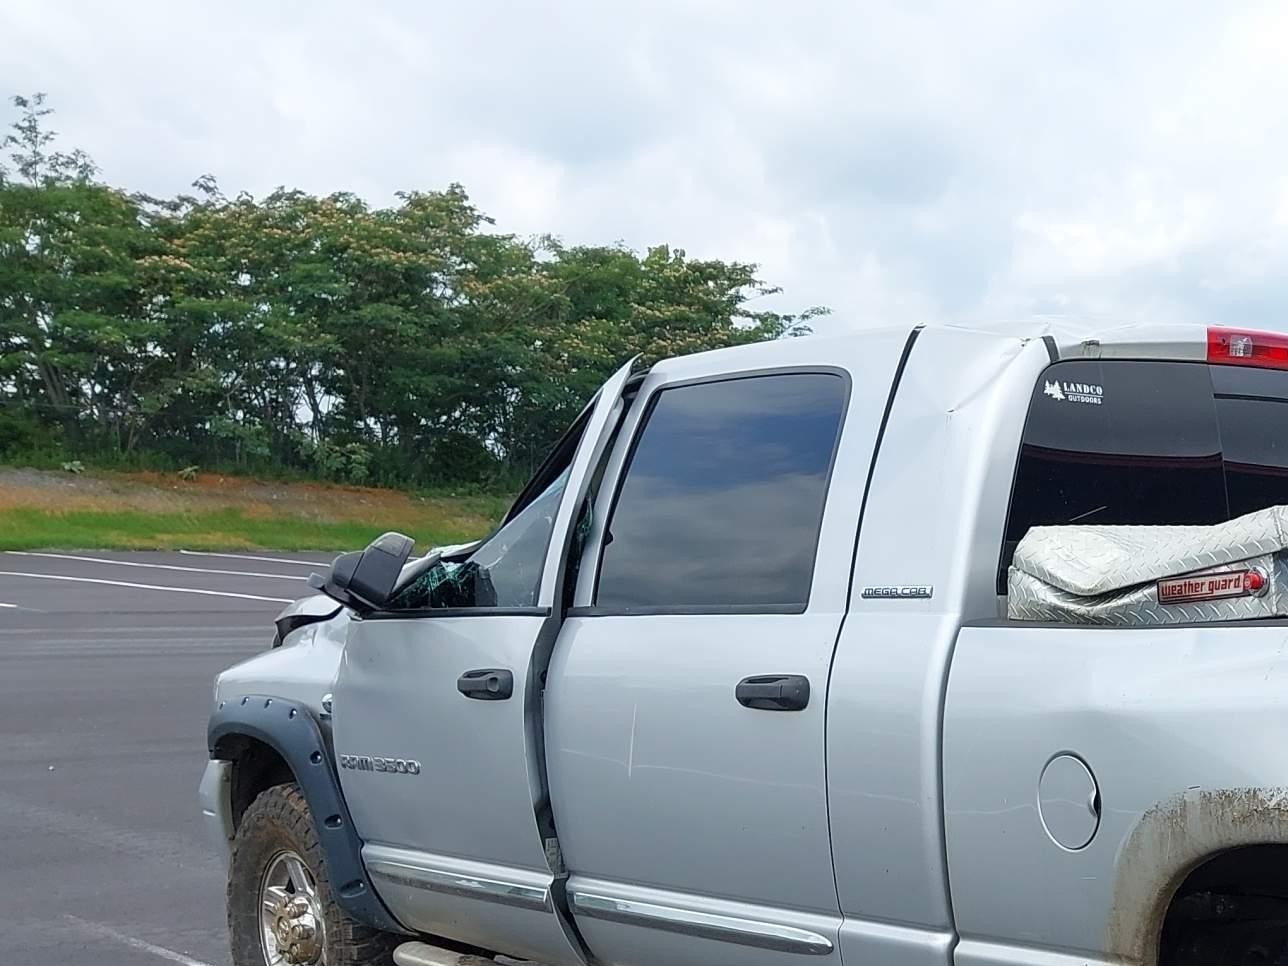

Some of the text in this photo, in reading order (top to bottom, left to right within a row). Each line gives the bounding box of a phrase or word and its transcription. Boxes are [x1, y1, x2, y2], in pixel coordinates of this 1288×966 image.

[1063, 382, 1103, 395] LANDCO
[1068, 395, 1102, 404] OUTDOORS
[863, 587, 928, 597] MEGA CAB
[1161, 574, 1241, 597] weather guard
[340, 754, 421, 775] RAM 3500
